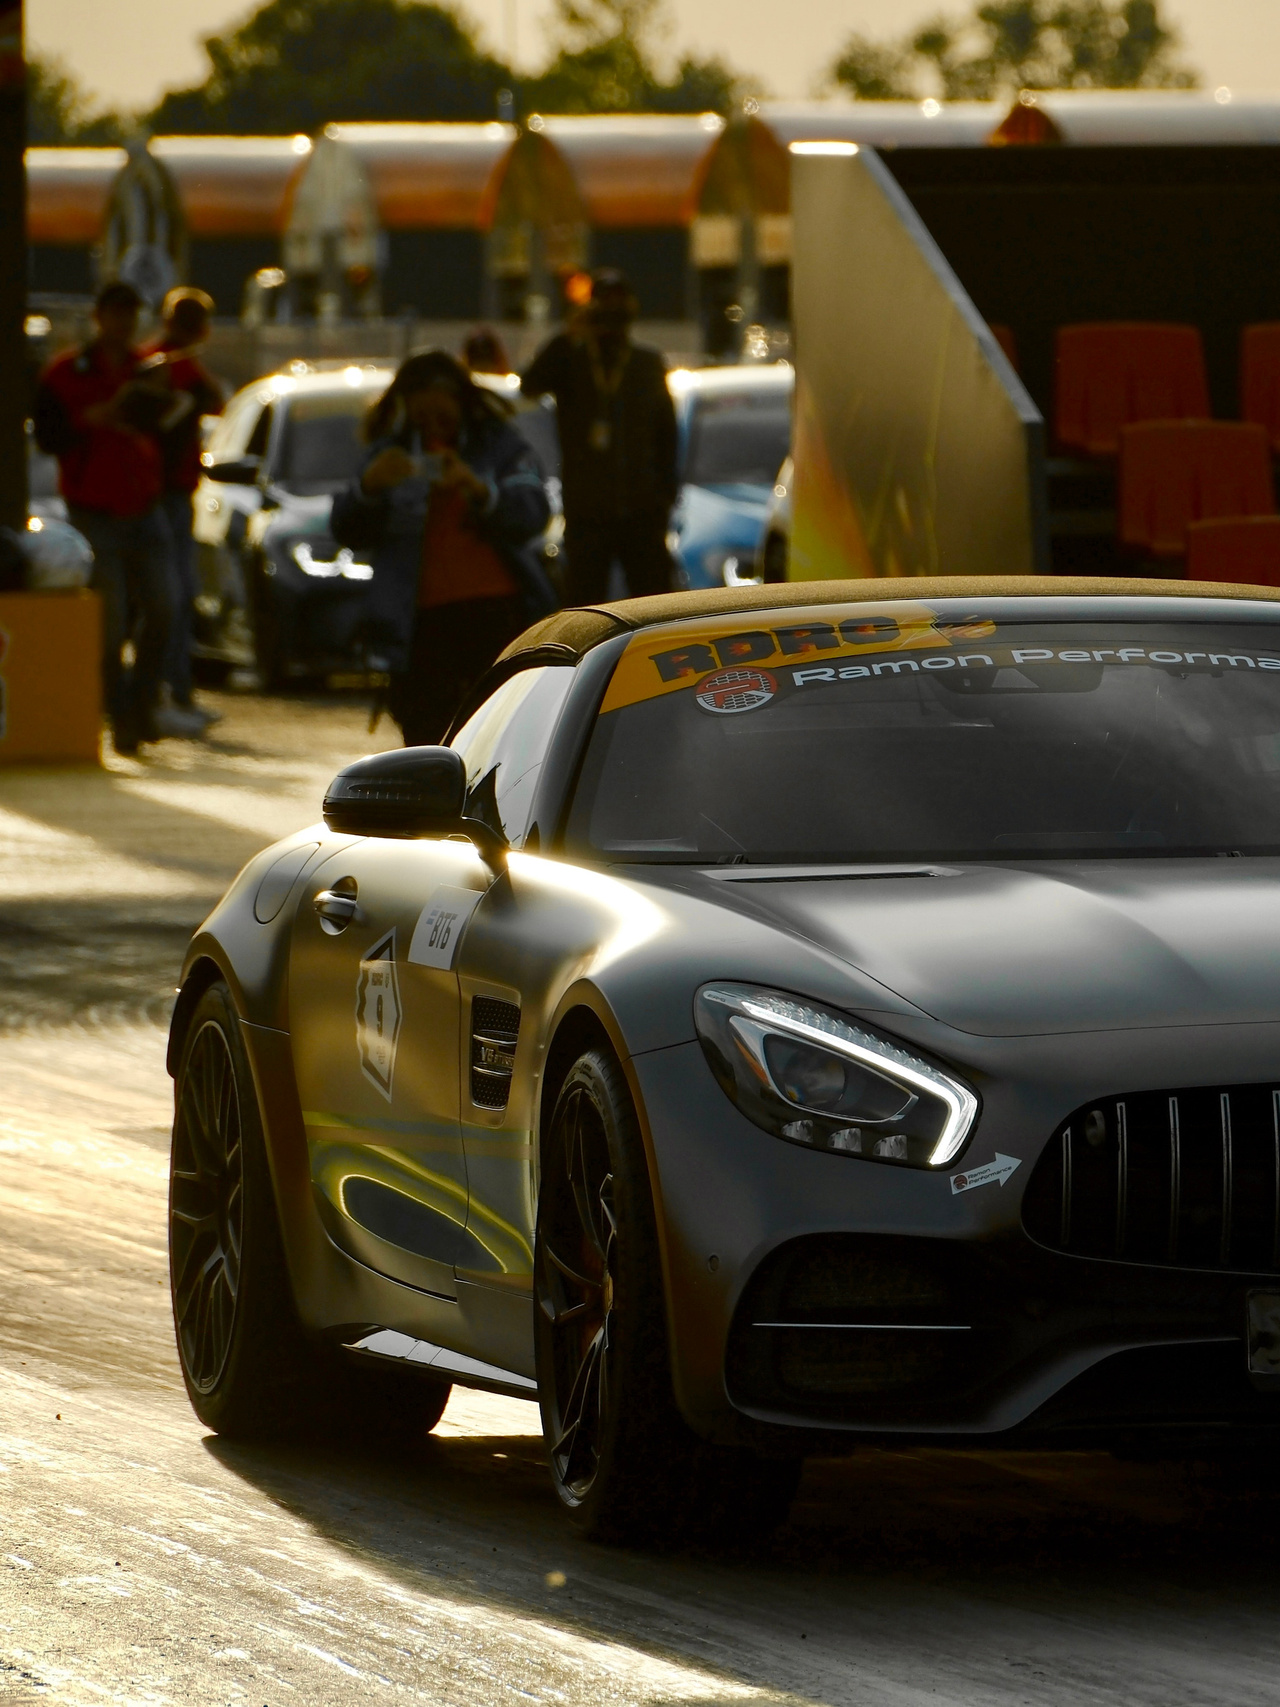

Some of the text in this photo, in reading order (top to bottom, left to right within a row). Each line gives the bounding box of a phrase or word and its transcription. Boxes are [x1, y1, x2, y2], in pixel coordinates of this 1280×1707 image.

[648, 616, 901, 683] RDRC
[791, 653, 994, 687] Ramon
[968, 1168, 991, 1179] Ramon
[969, 1166, 1012, 1185] Performance
